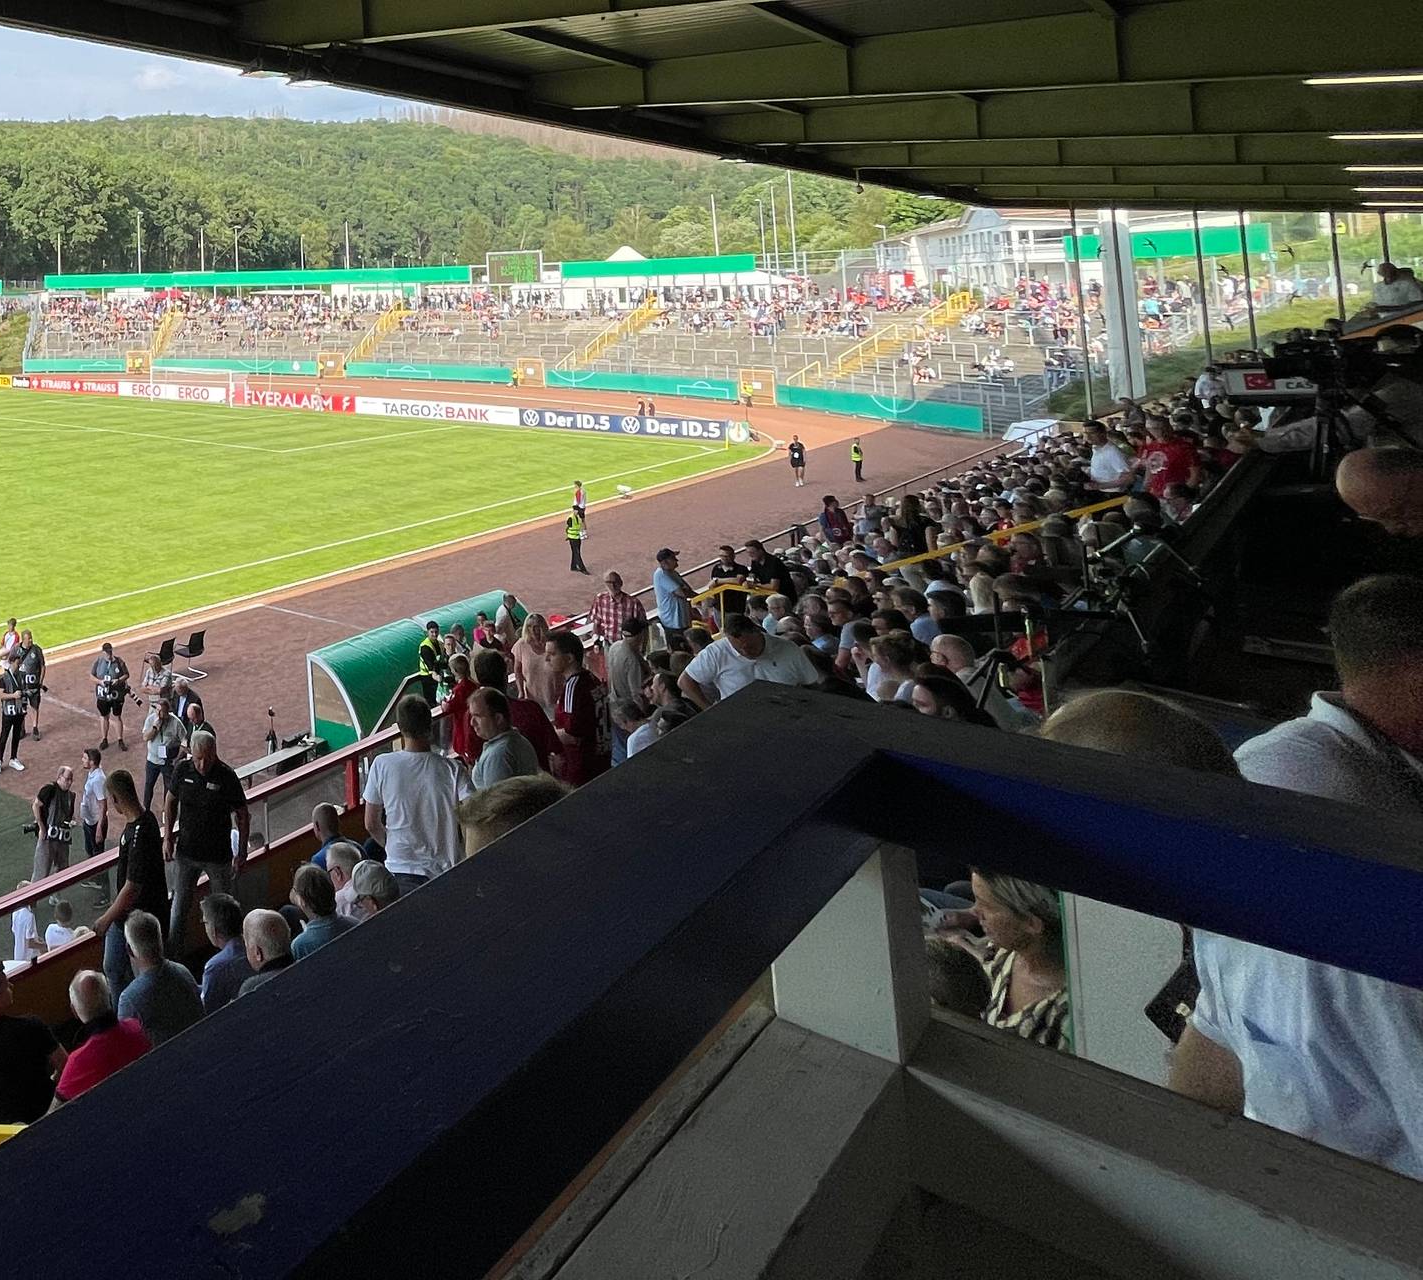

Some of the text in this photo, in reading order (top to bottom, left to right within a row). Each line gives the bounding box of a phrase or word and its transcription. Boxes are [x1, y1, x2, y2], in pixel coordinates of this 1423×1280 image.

[40, 379, 117, 393] STRAUSS STRAUSS
[177, 387, 210, 401] ERGO
[545, 411, 573, 428] Der
[576, 413, 611, 430] ID.5
[646, 418, 679, 436] Der
[682, 421, 721, 439] ID.5
